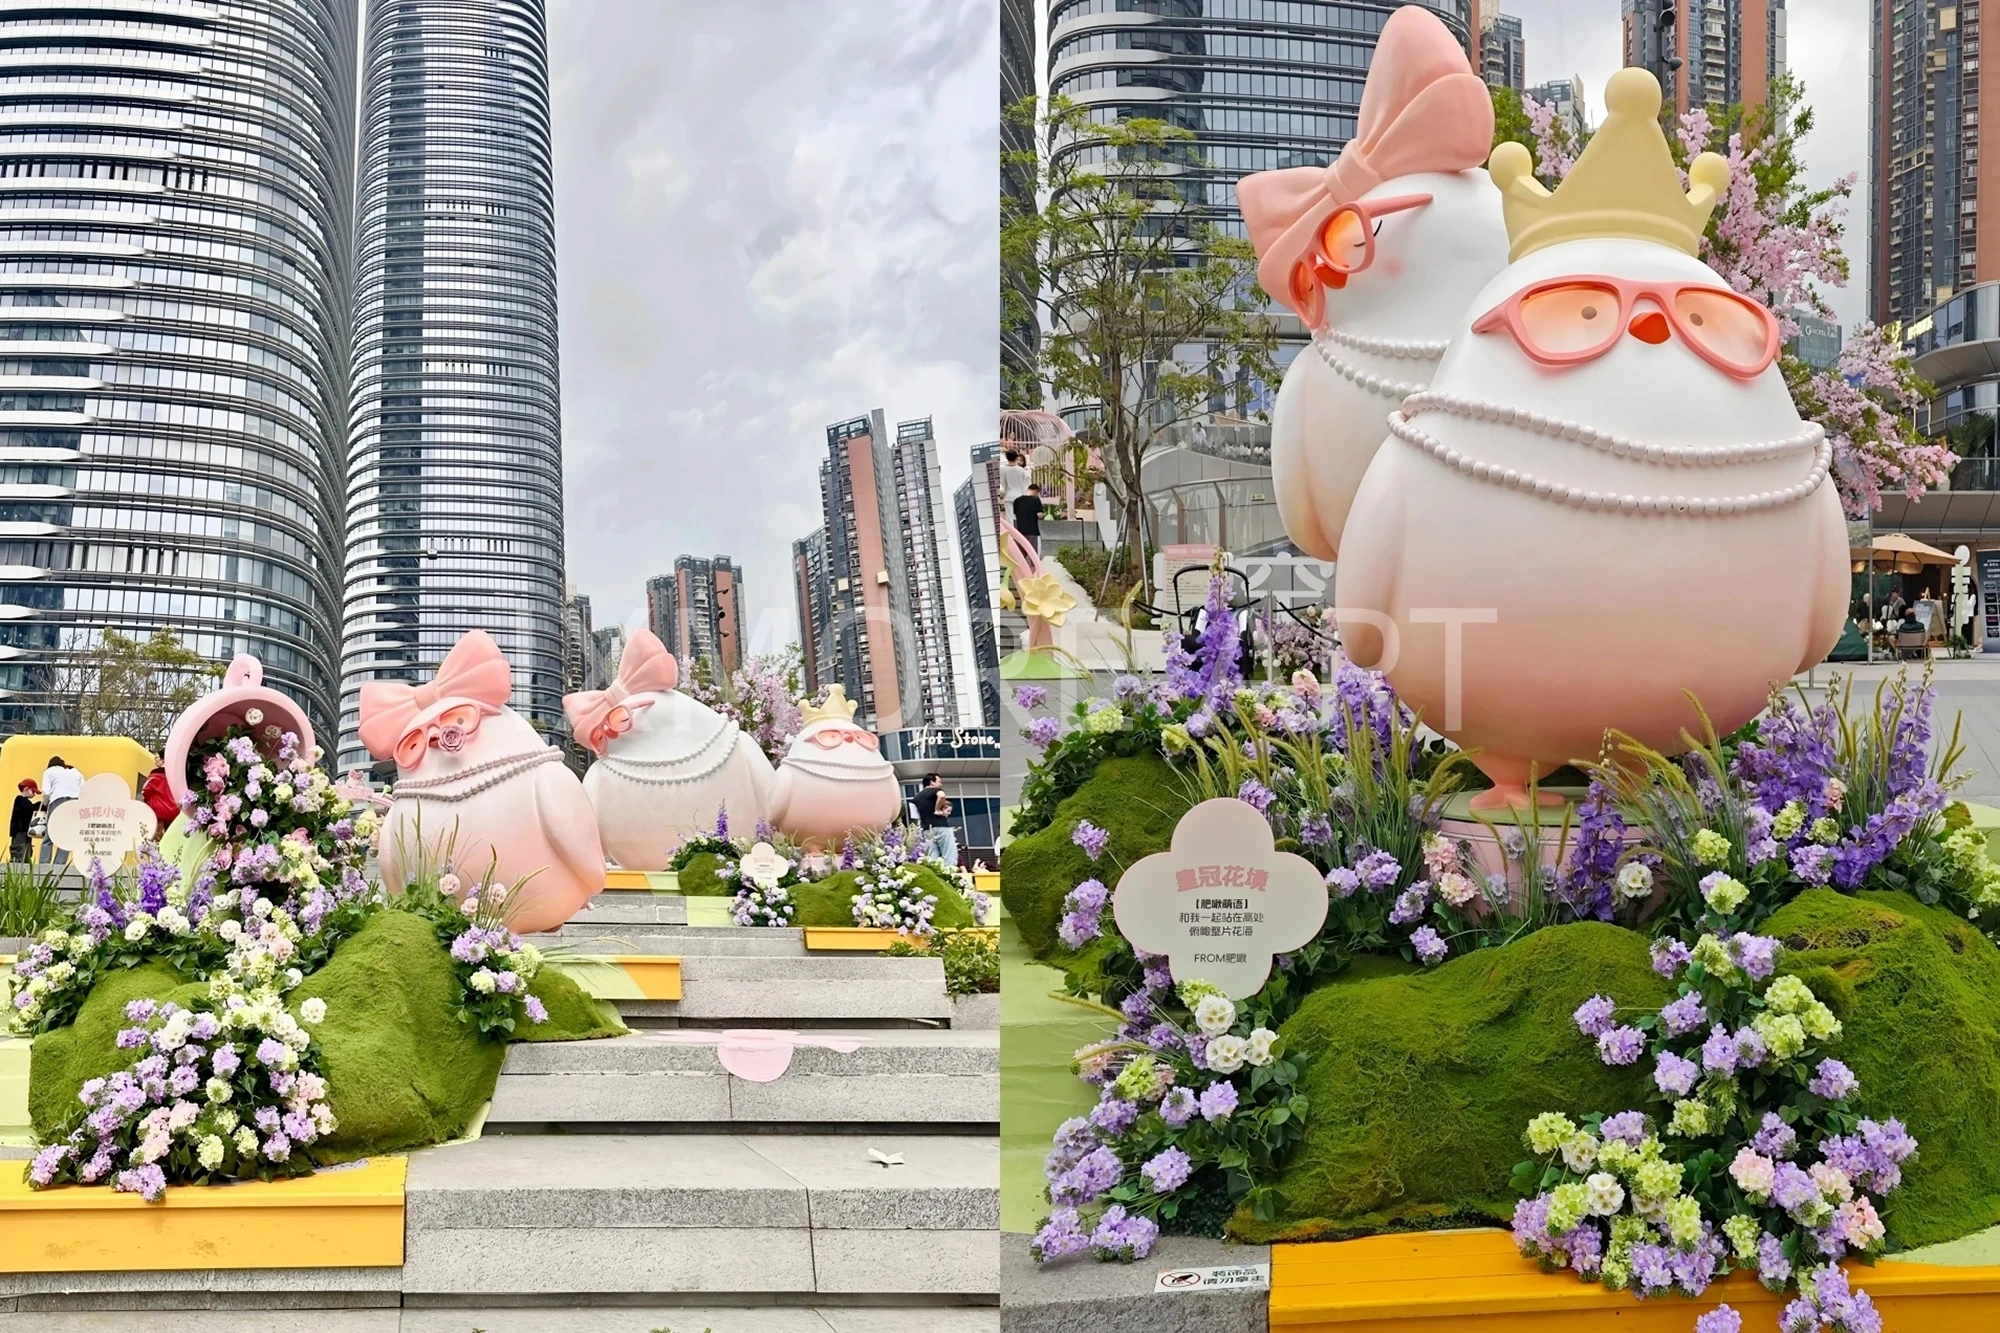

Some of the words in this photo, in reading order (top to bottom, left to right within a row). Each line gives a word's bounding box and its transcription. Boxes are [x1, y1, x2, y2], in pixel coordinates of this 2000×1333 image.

[907, 723, 944, 754] Hot
[950, 727, 996, 748] Stone
[1175, 865, 1269, 892] 皇冠花境
[1178, 912, 1264, 924] 和我一起站在高处
[1189, 925, 1254, 937] 俯瞰整片花海
